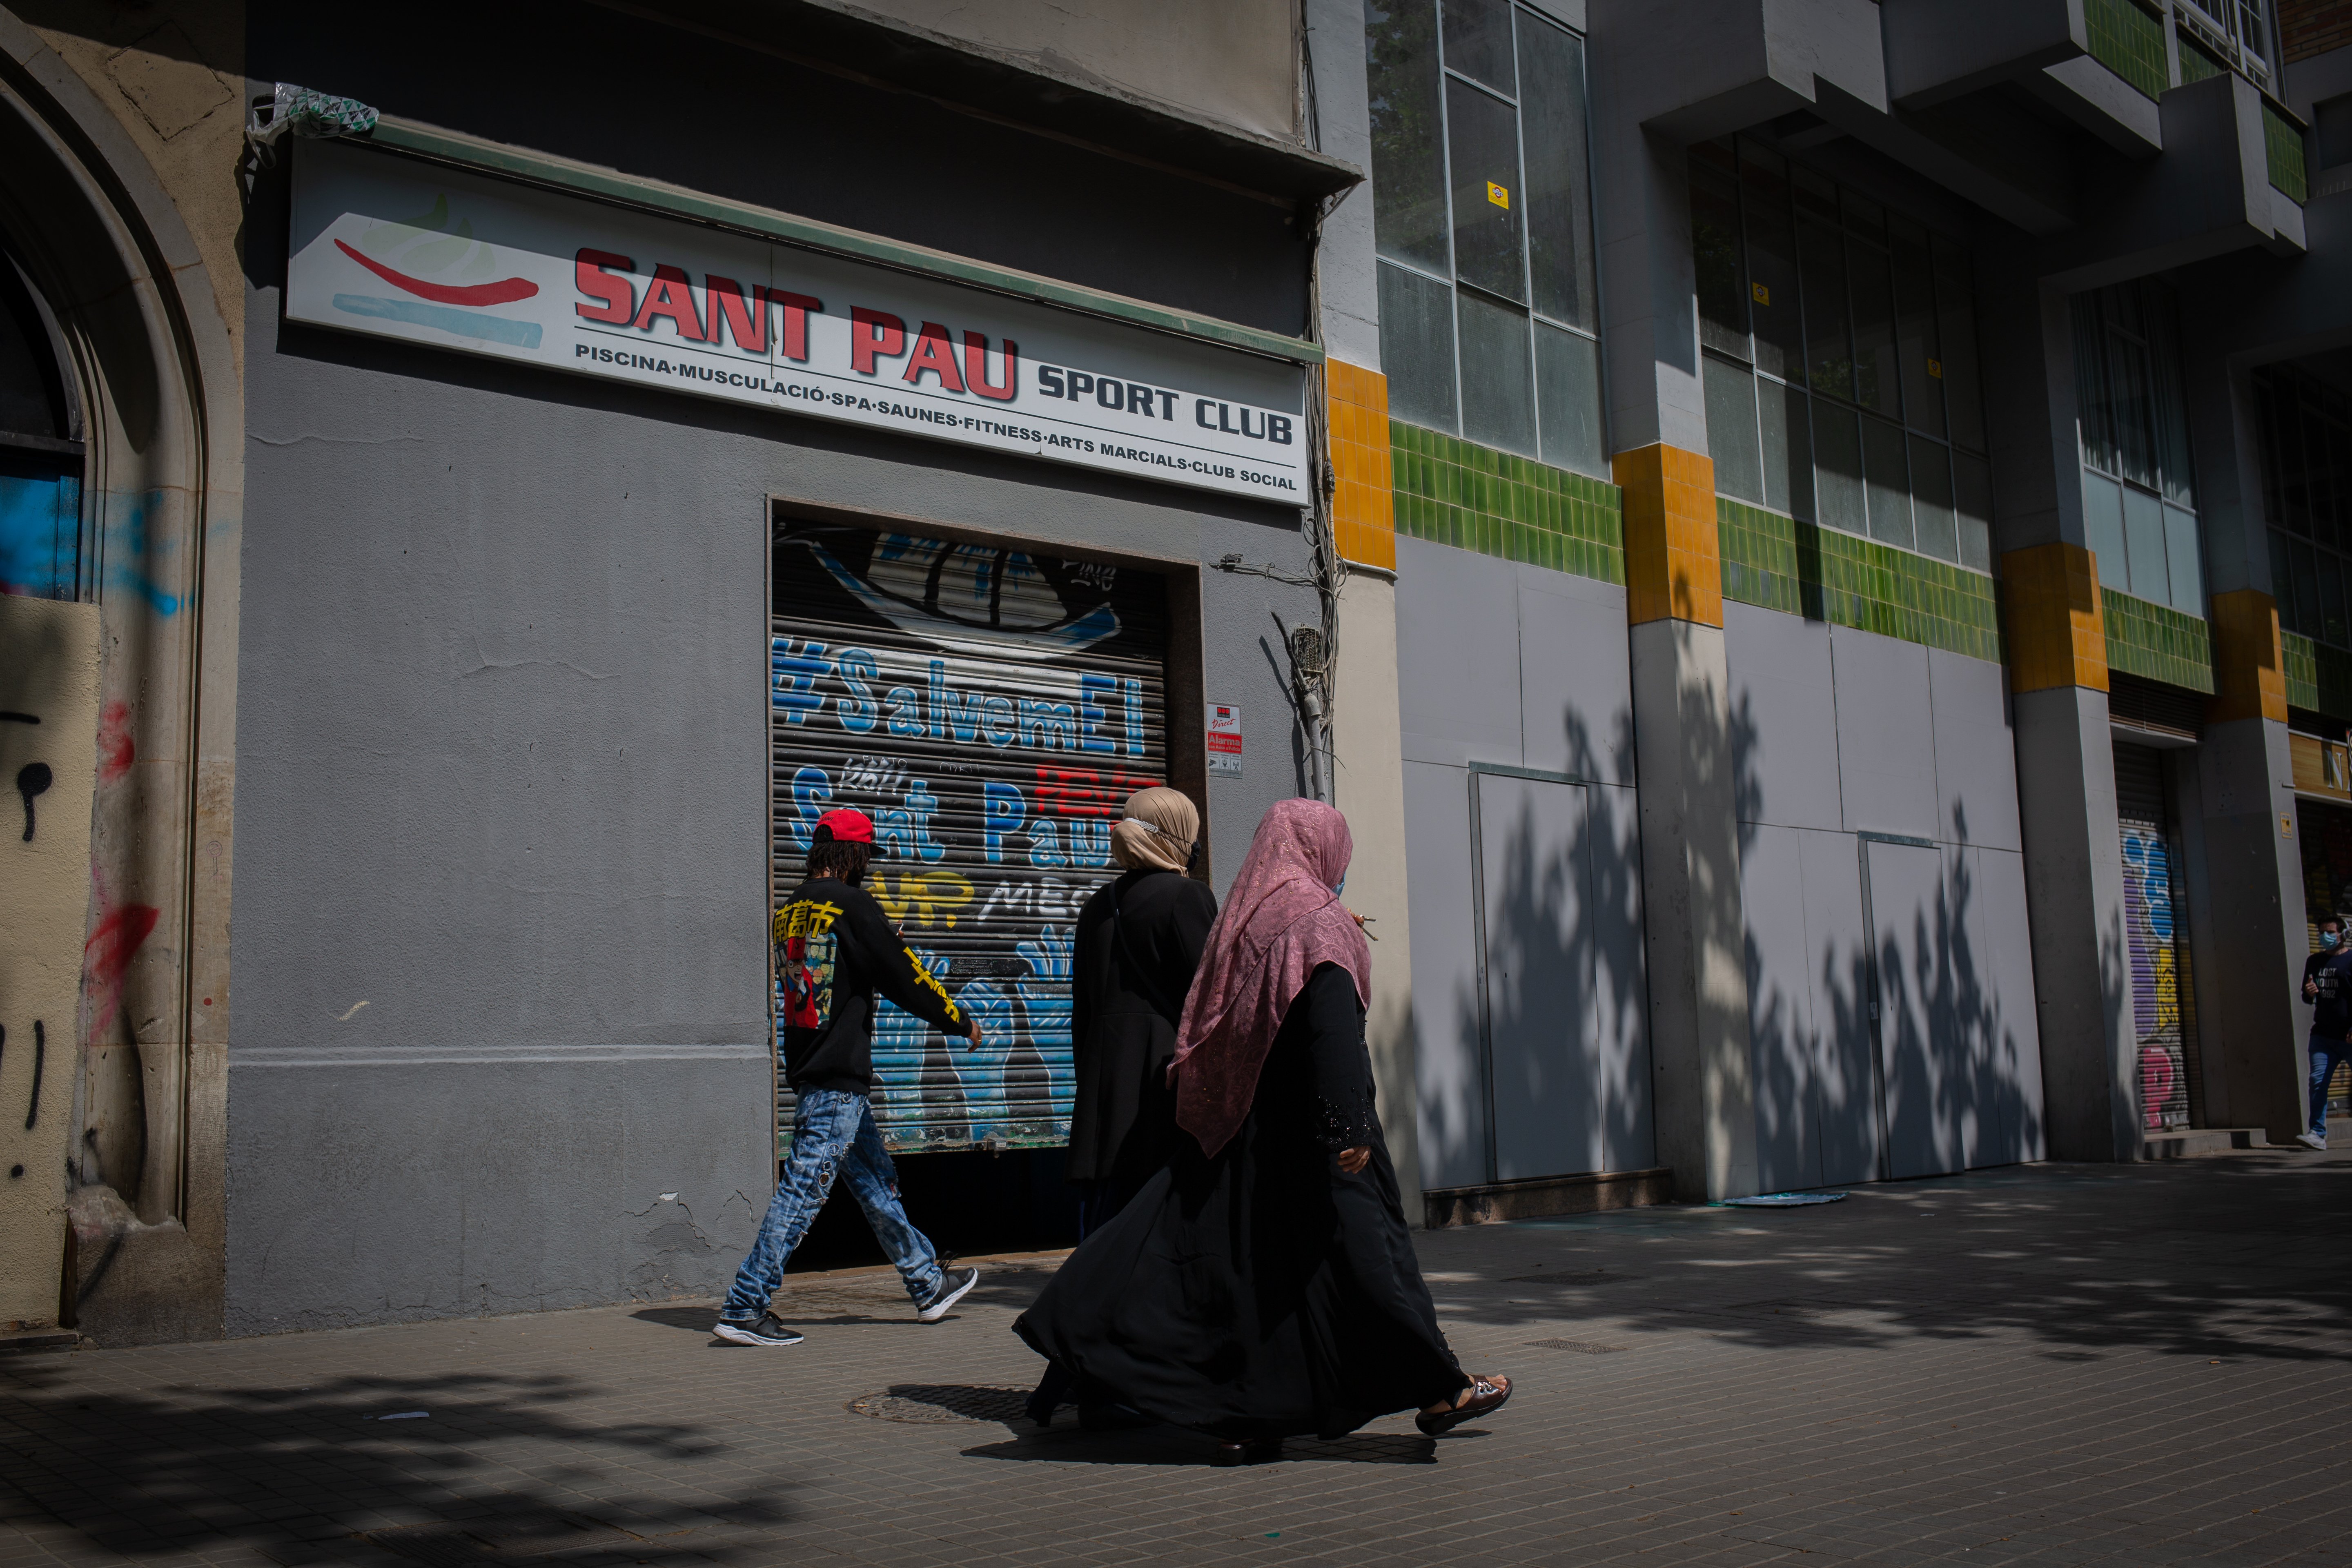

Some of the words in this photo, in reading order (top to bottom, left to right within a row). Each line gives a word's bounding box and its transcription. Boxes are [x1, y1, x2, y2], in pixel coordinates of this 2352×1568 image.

[575, 248, 824, 361] SANT
[850, 305, 1016, 401] PAU
[1039, 365, 1180, 422] SPORT
[1195, 398, 1292, 445] CLUB
[1240, 470, 1297, 491] SOCIAL
[1212, 719, 1236, 729] Direct
[1209, 734, 1240, 746] Alarma
[773, 899, 844, 945] 南葛市
[2319, 967, 2337, 977] LOST
[2315, 978, 2339, 988] YOUTH
